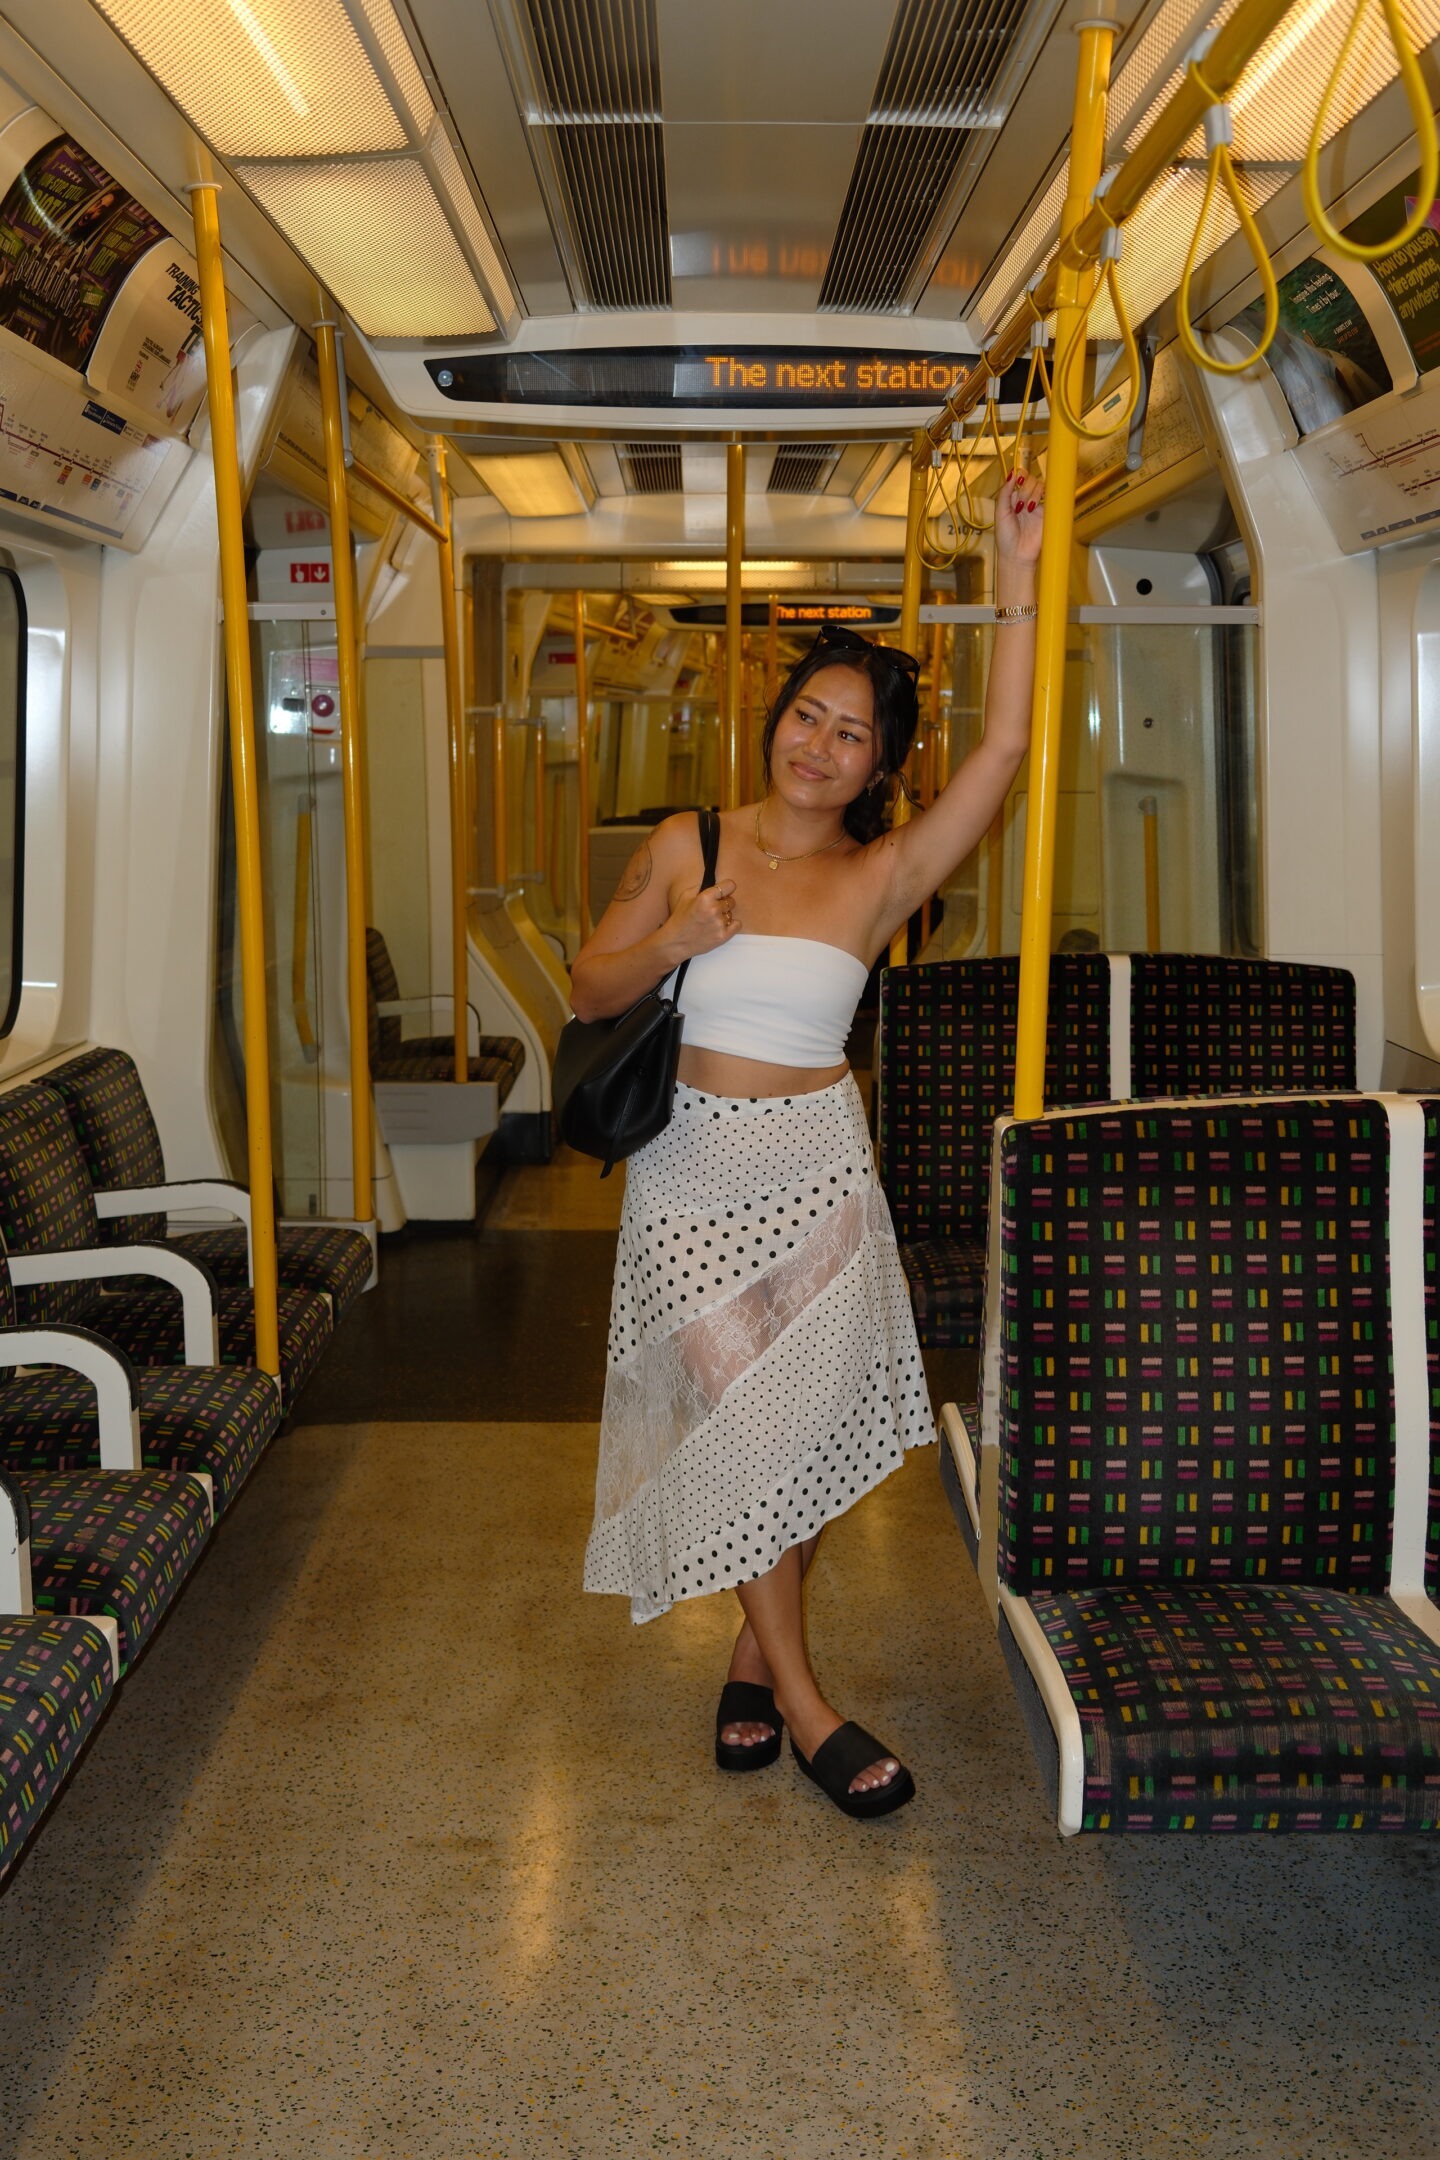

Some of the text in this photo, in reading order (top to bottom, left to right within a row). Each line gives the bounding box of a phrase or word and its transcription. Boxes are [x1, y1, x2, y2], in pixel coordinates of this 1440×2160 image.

[1373, 229, 1439, 279] How do you say
[165, 262, 200, 296] TRAINING
[1405, 257, 1440, 287] anyone,
[1319, 295, 1332, 306] by
[704, 357, 969, 389] The next station
[776, 606, 872, 619] The next station
